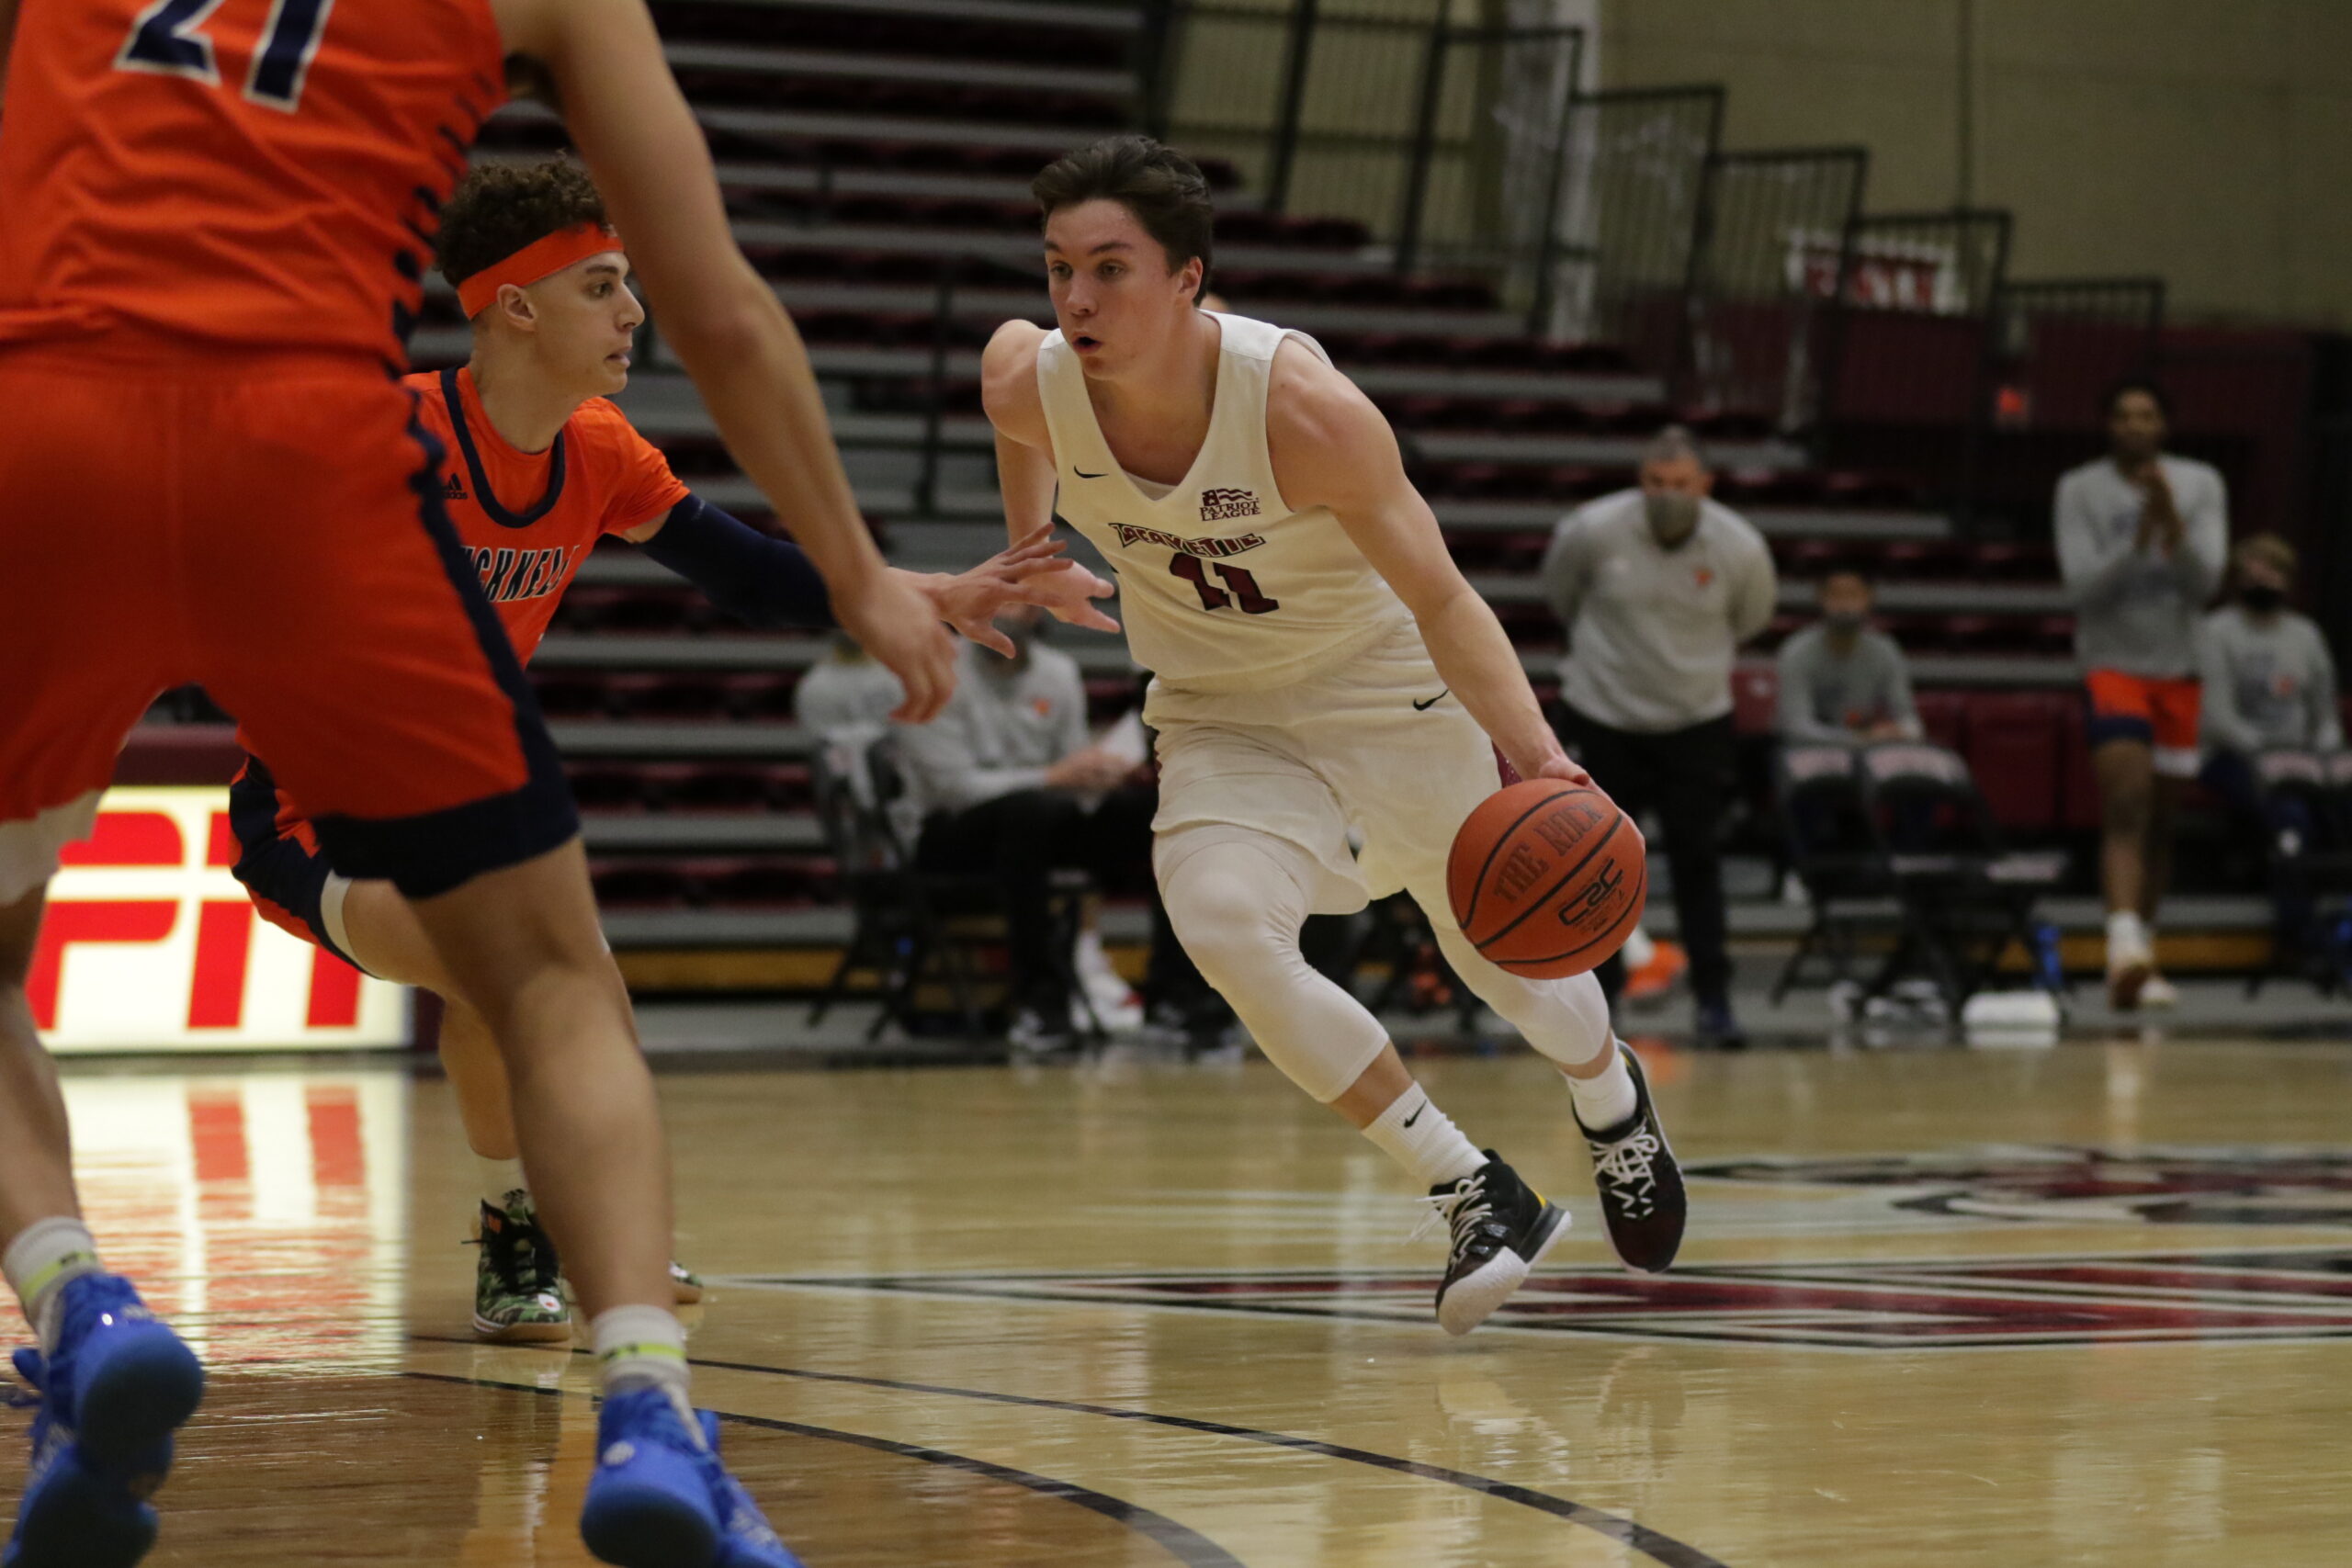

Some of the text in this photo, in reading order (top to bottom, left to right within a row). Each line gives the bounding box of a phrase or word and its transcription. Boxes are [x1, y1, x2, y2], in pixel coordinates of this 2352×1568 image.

[1199, 499, 1261, 514] PATRIOT
[1202, 508, 1261, 522] LEAGUE
[1169, 552, 1280, 615] 11
[1494, 841, 1550, 903] THE
